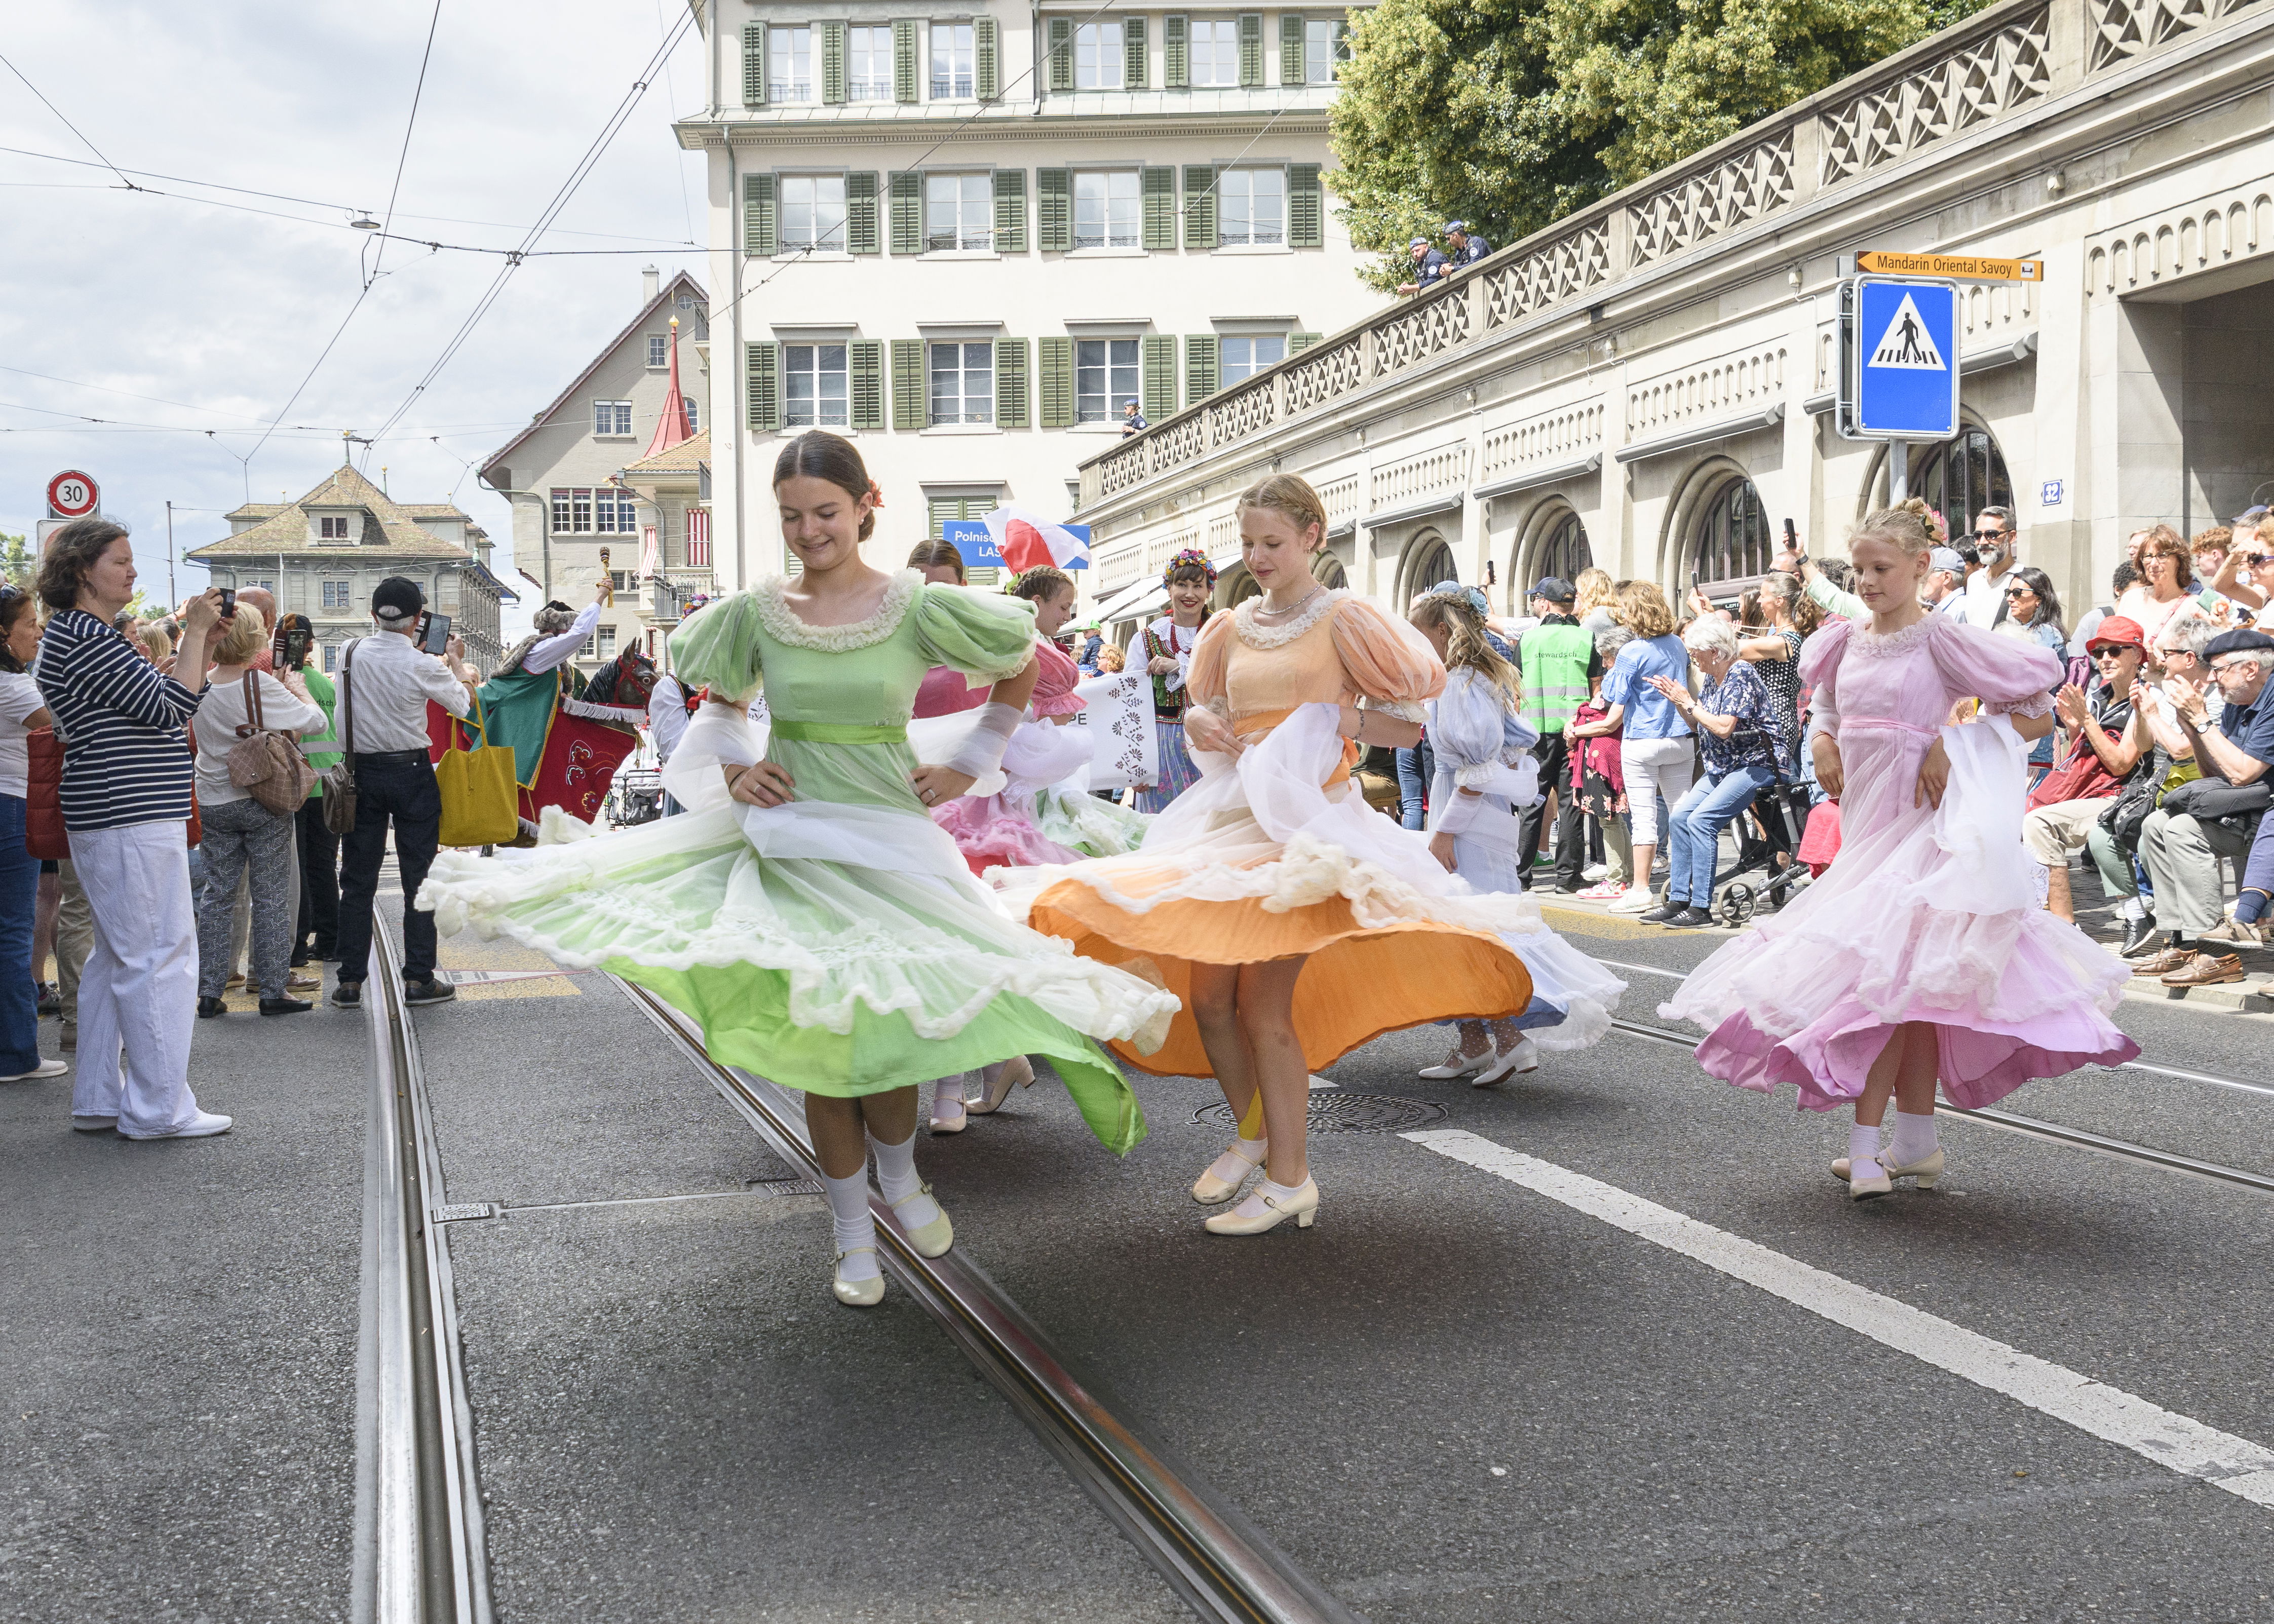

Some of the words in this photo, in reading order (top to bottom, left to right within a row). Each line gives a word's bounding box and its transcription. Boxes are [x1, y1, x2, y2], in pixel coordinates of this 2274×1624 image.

[1877, 255, 1929, 270] Mandarin
[1934, 258, 1977, 273] Oriental
[1981, 260, 2012, 279] Savoy
[63, 485, 83, 502] 30
[2045, 483, 2059, 502] 32
